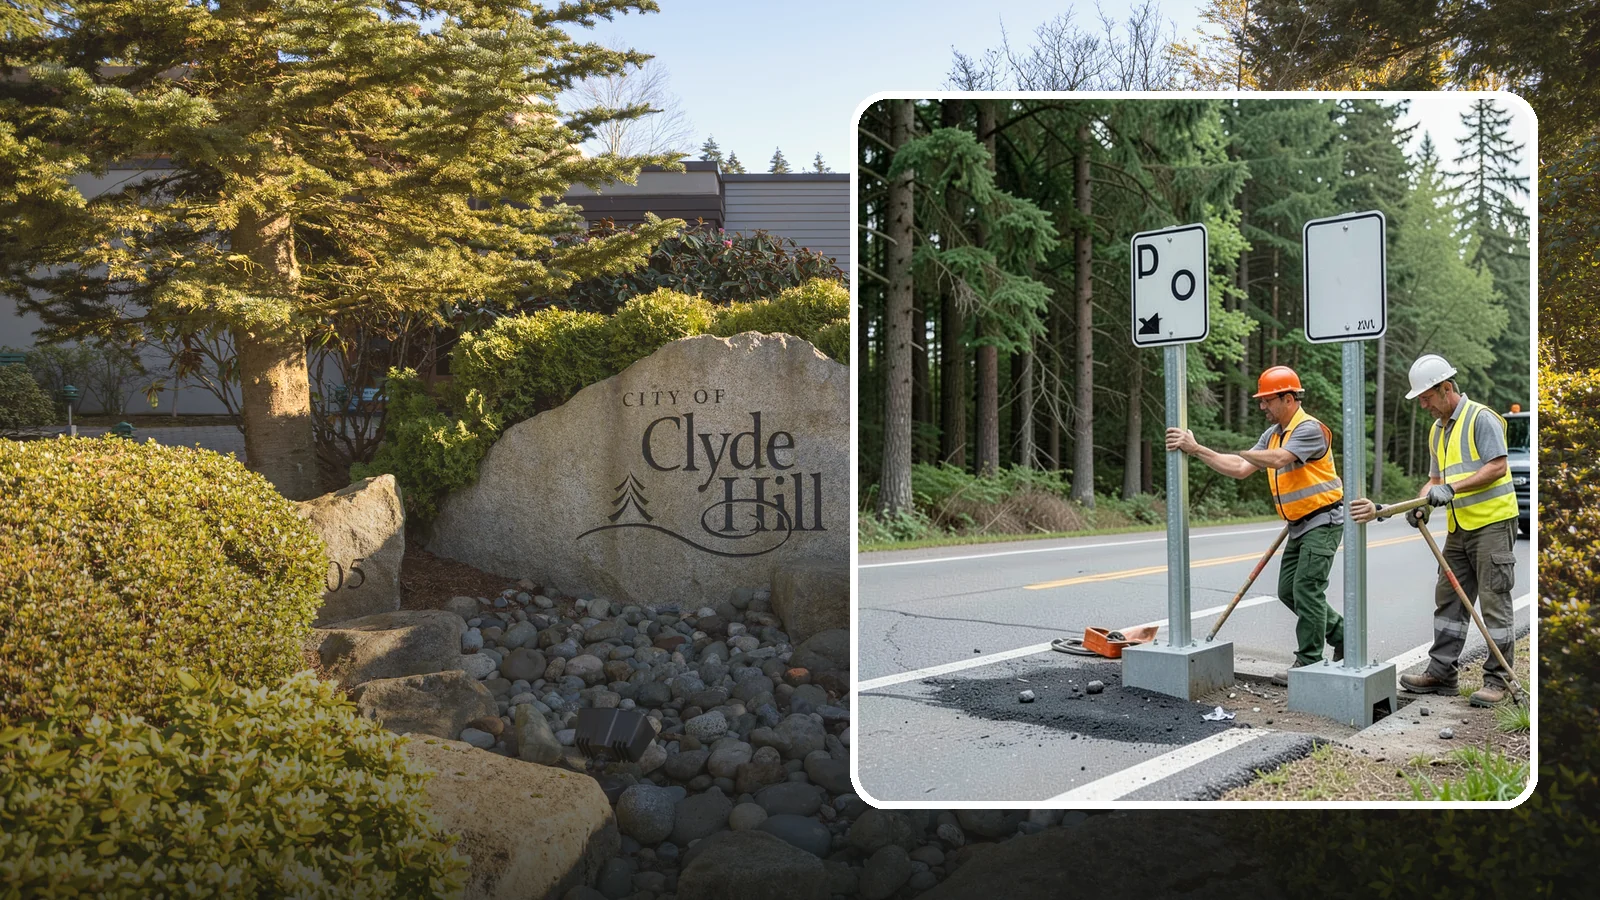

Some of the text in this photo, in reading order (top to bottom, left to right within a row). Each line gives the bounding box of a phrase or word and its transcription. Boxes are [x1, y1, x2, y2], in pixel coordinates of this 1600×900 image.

[622, 388, 725, 407] CITY OF
[641, 410, 795, 493] Clyde
[718, 471, 828, 533] Hill
